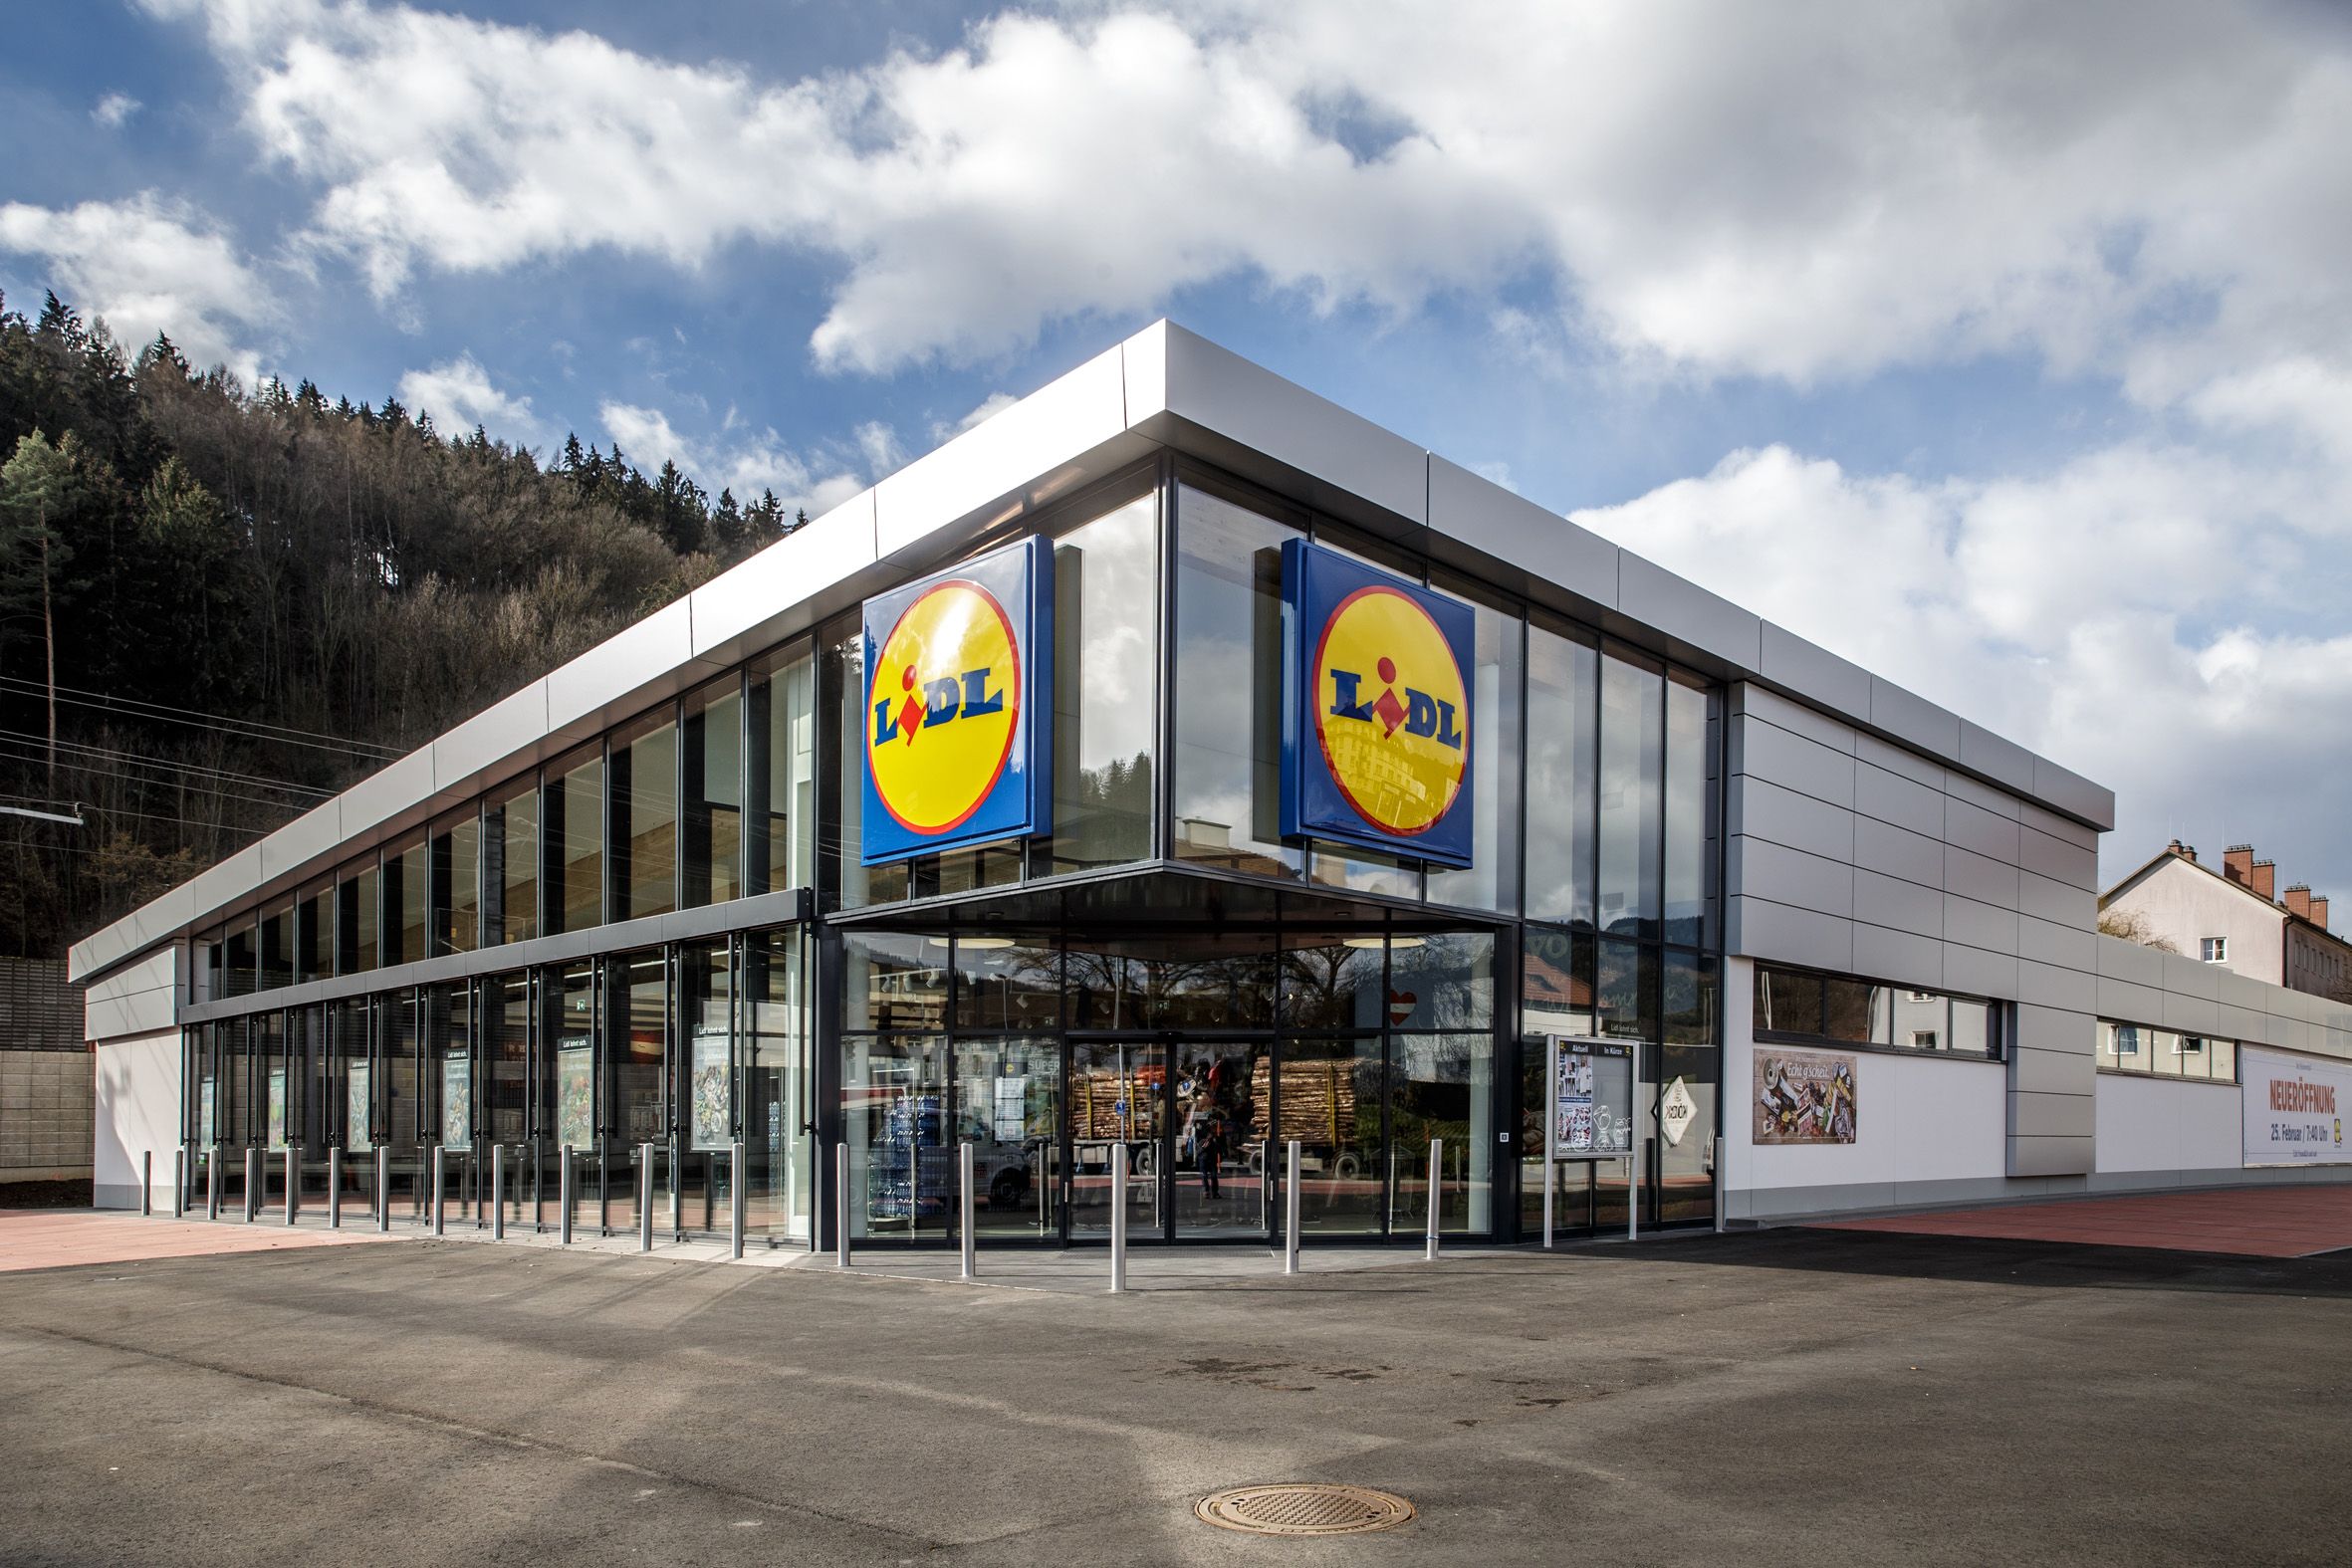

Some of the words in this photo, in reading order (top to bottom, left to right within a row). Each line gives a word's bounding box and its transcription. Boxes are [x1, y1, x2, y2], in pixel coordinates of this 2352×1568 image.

[1572, 1044, 1589, 1053] Aktuell
[1787, 1062, 1802, 1077] Echt
[2270, 1076, 2335, 1114] NEUERÖFFNUNG
[2271, 1123, 2281, 1141] 25.
[2282, 1123, 2302, 1141] Februar
[2319, 1125, 2328, 1141] Uhr
